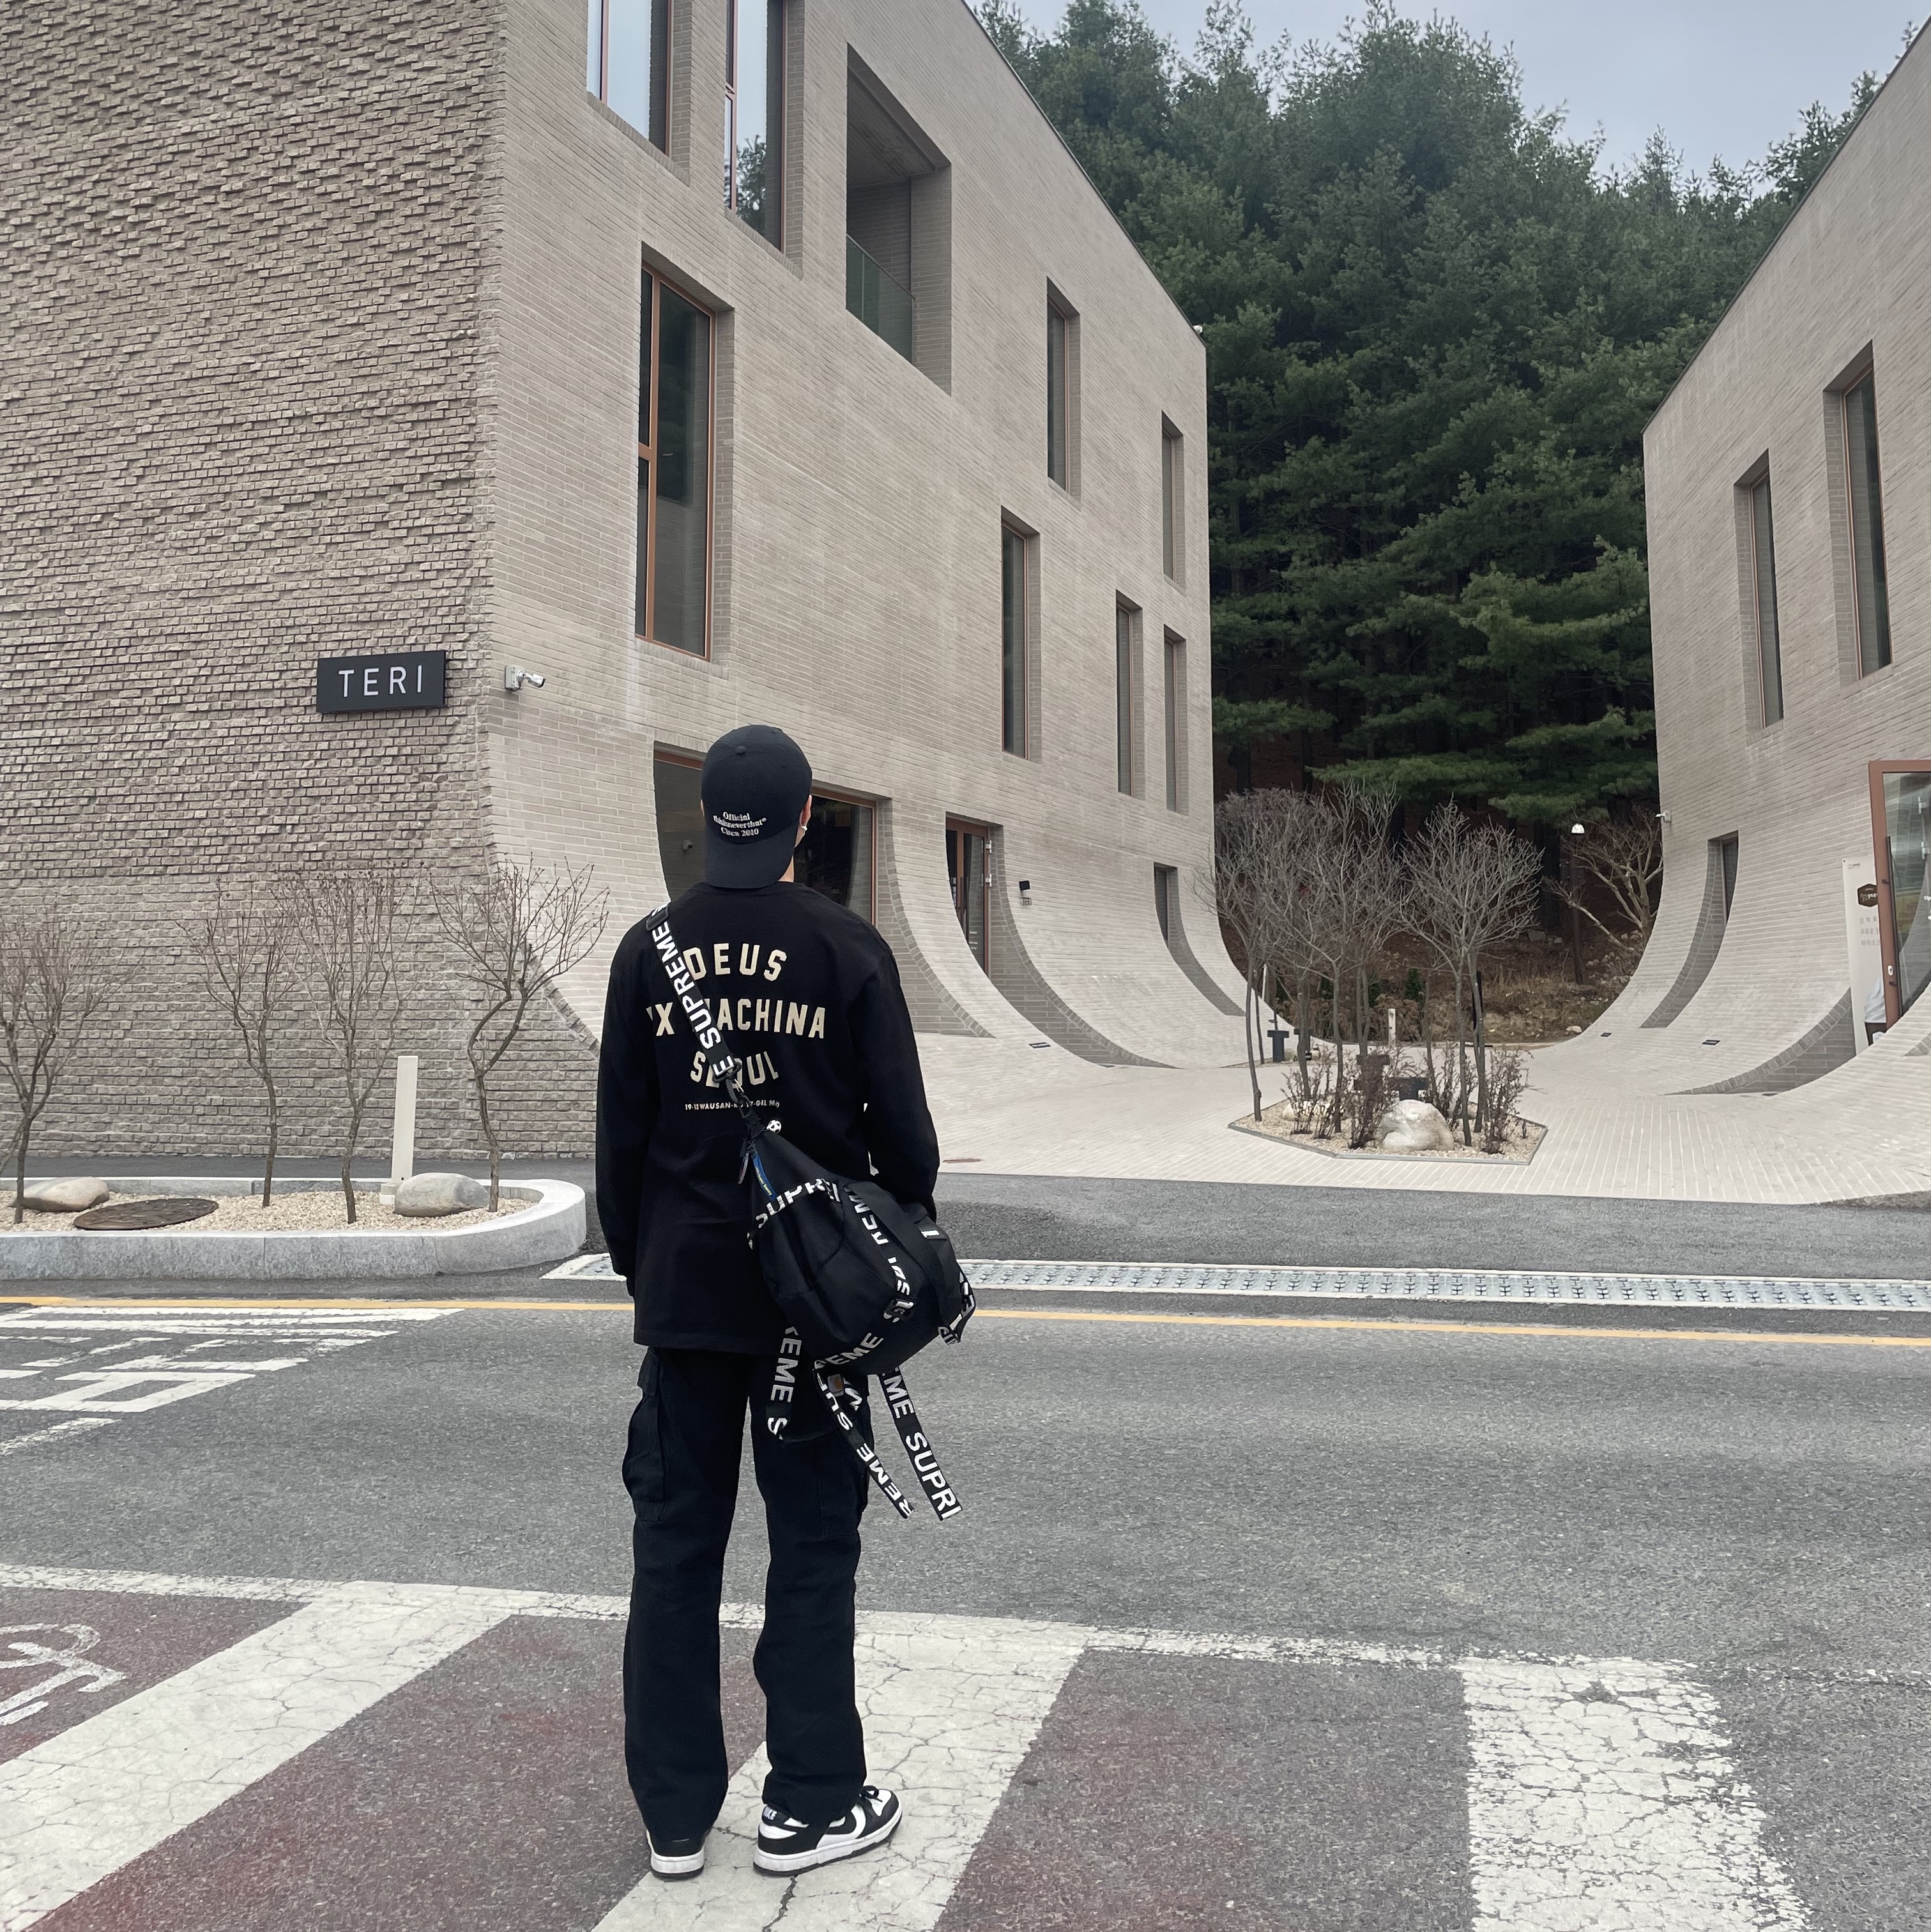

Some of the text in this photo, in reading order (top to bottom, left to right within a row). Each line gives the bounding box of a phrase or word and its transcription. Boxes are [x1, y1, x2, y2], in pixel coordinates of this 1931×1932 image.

[339, 665, 422, 697] TERI
[741, 828, 759, 837] 2010
[683, 943, 787, 981] DEUS
[652, 921, 721, 1049] SUPREME
[646, 998, 825, 1039] X ACHINA
[882, 1367, 915, 1419] ME
